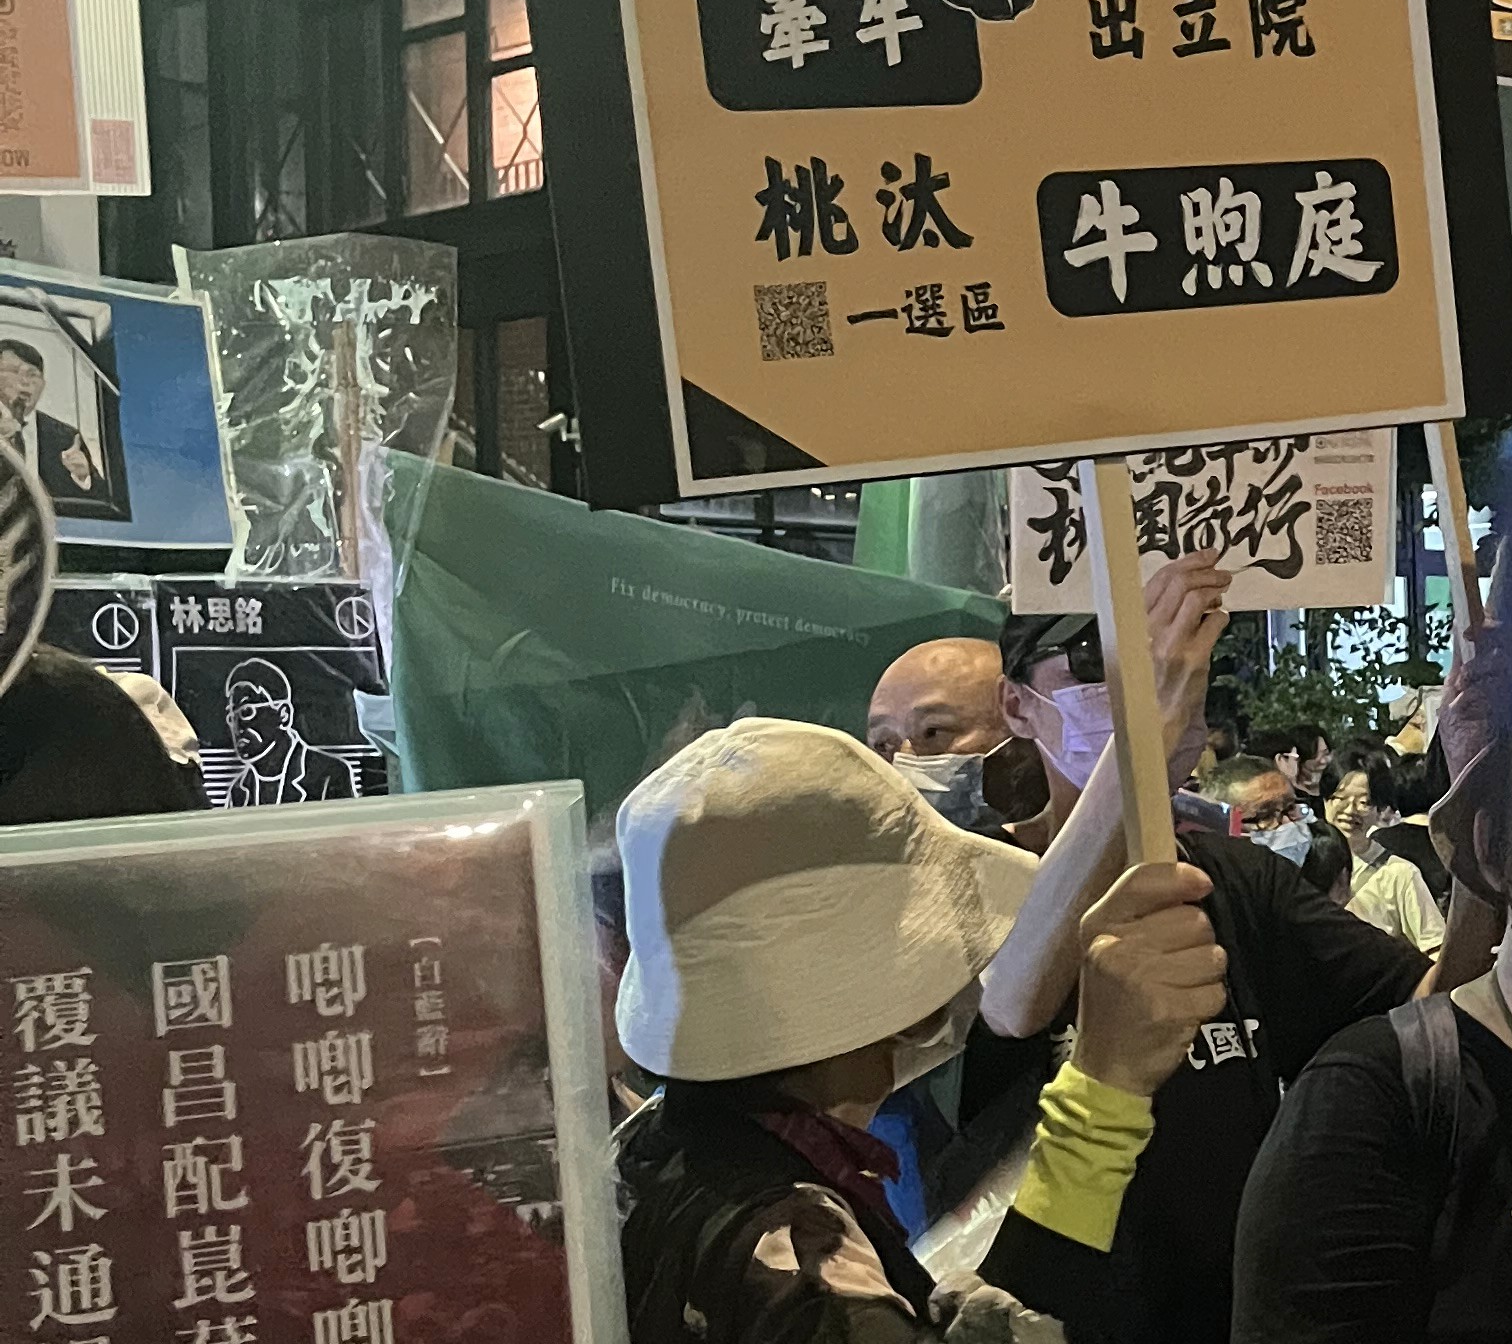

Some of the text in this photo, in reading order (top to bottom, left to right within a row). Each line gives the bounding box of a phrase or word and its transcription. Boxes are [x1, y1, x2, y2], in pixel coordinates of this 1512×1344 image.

[754, 154, 974, 260] 桃汰
[1063, 170, 1385, 303] 牛煦庭
[846, 281, 1007, 338] 一選區
[170, 596, 263, 636] 林思銘
